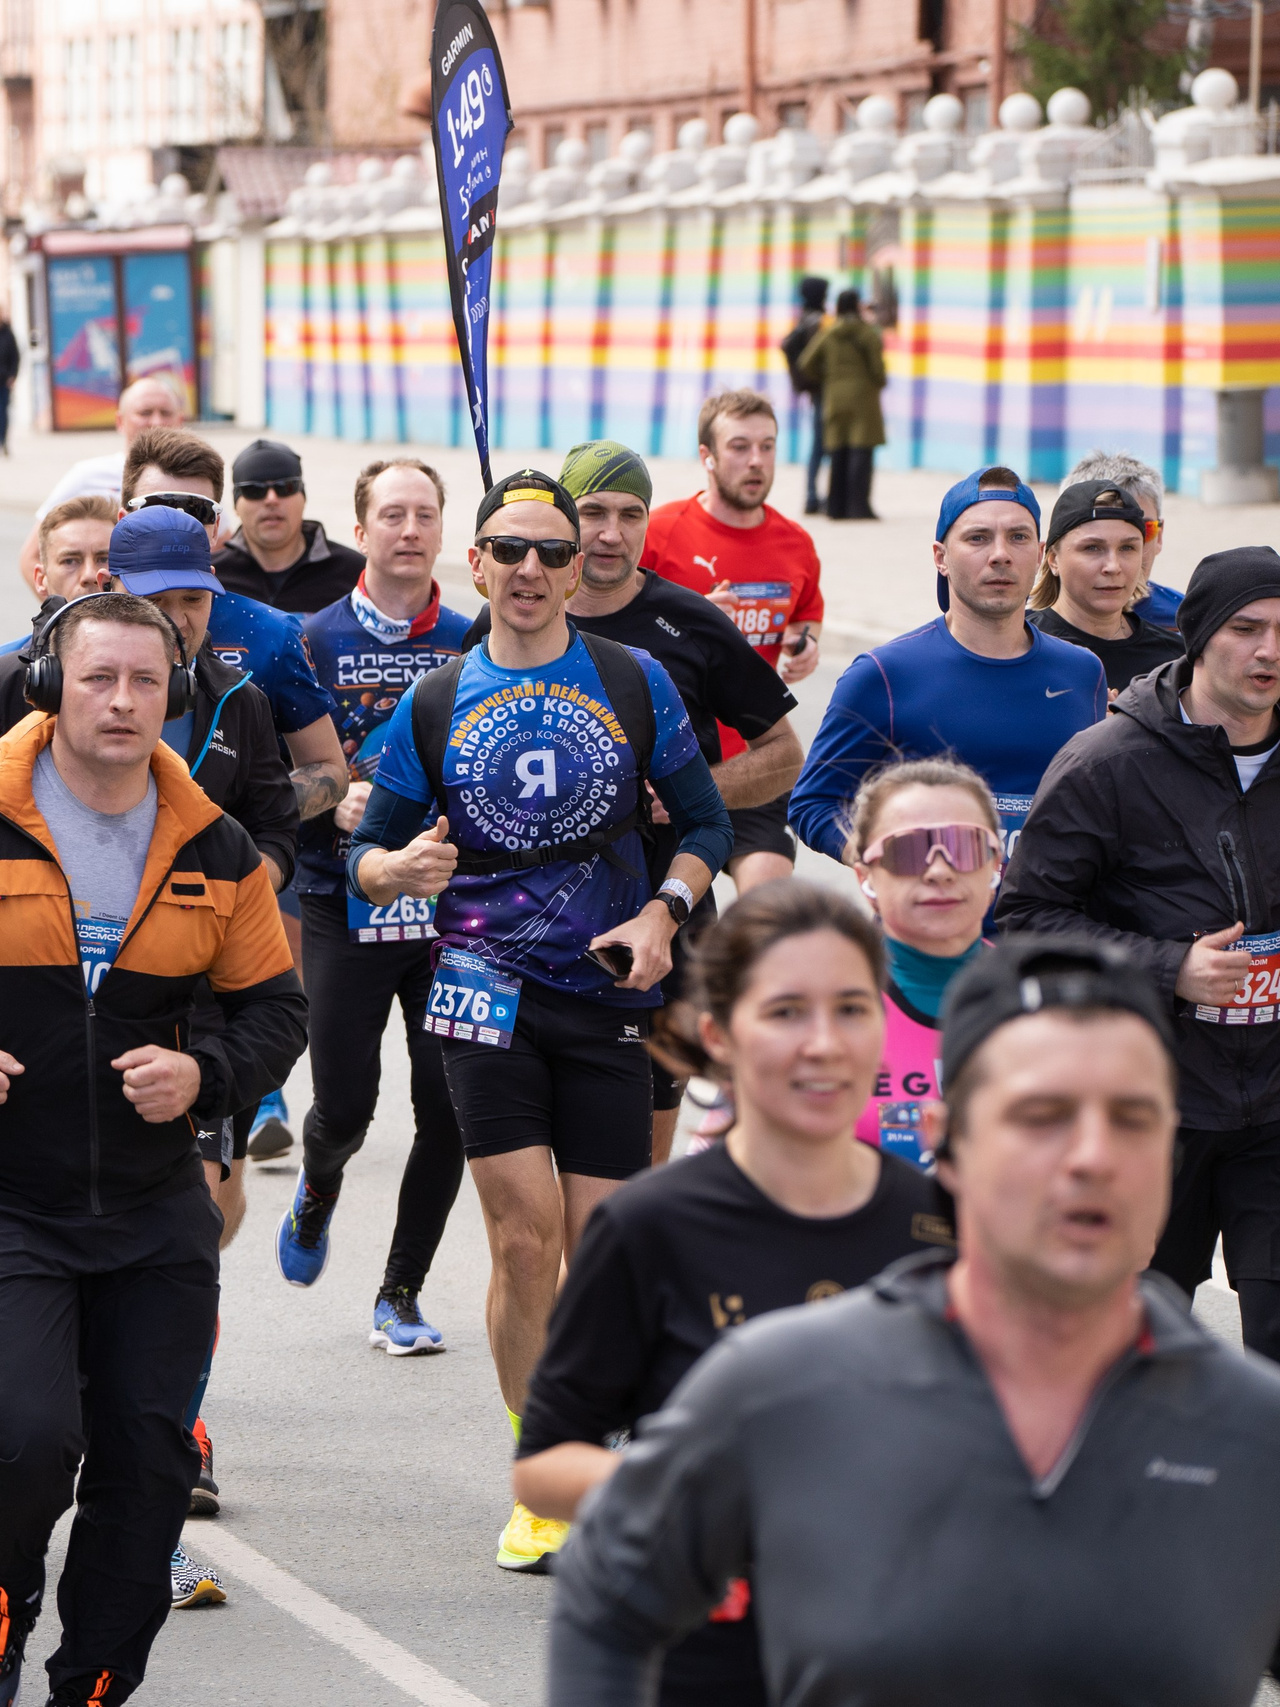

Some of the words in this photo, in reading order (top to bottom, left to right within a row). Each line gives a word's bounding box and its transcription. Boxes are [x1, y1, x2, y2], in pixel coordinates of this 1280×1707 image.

[441, 23, 474, 76] GARMIN
[447, 69, 485, 169] 1:49
[655, 616, 680, 637] 2XU
[732, 607, 771, 633] 186
[338, 655, 355, 668] Я
[449, 680, 545, 748] КОСМИЧЕСКИЙ
[549, 683, 628, 745] ПЕЙСМЕЙКЕР
[459, 697, 536, 757] ПРОСТО
[542, 714, 553, 725] Я
[543, 697, 619, 767] КОСМОС
[557, 717, 604, 774] ПРОСТО
[208, 742, 237, 759] RDSKI
[472, 719, 518, 782] КОСМОС
[491, 731, 532, 766] ПРОСТО
[536, 730, 584, 763] КОСМОС
[455, 763, 470, 775] Я
[488, 767, 498, 775] Я
[515, 749, 557, 799] Я
[550, 781, 586, 819] ПРОСТО
[604, 783, 618, 797] Я
[474, 786, 525, 834] ПРОСТО
[497, 796, 547, 822] КОСМОС
[551, 778, 604, 834] КОСМОС
[994, 804, 1031, 812] ОСМО
[529, 826, 539, 837] Я
[368, 895, 430, 925] 2263
[77, 930, 124, 942] ОСМОС
[80, 946, 106, 955] ЮРИЙ
[447, 952, 486, 967] ПРОСТО
[431, 981, 491, 1022] 2376
[496, 1007, 506, 1017] D
